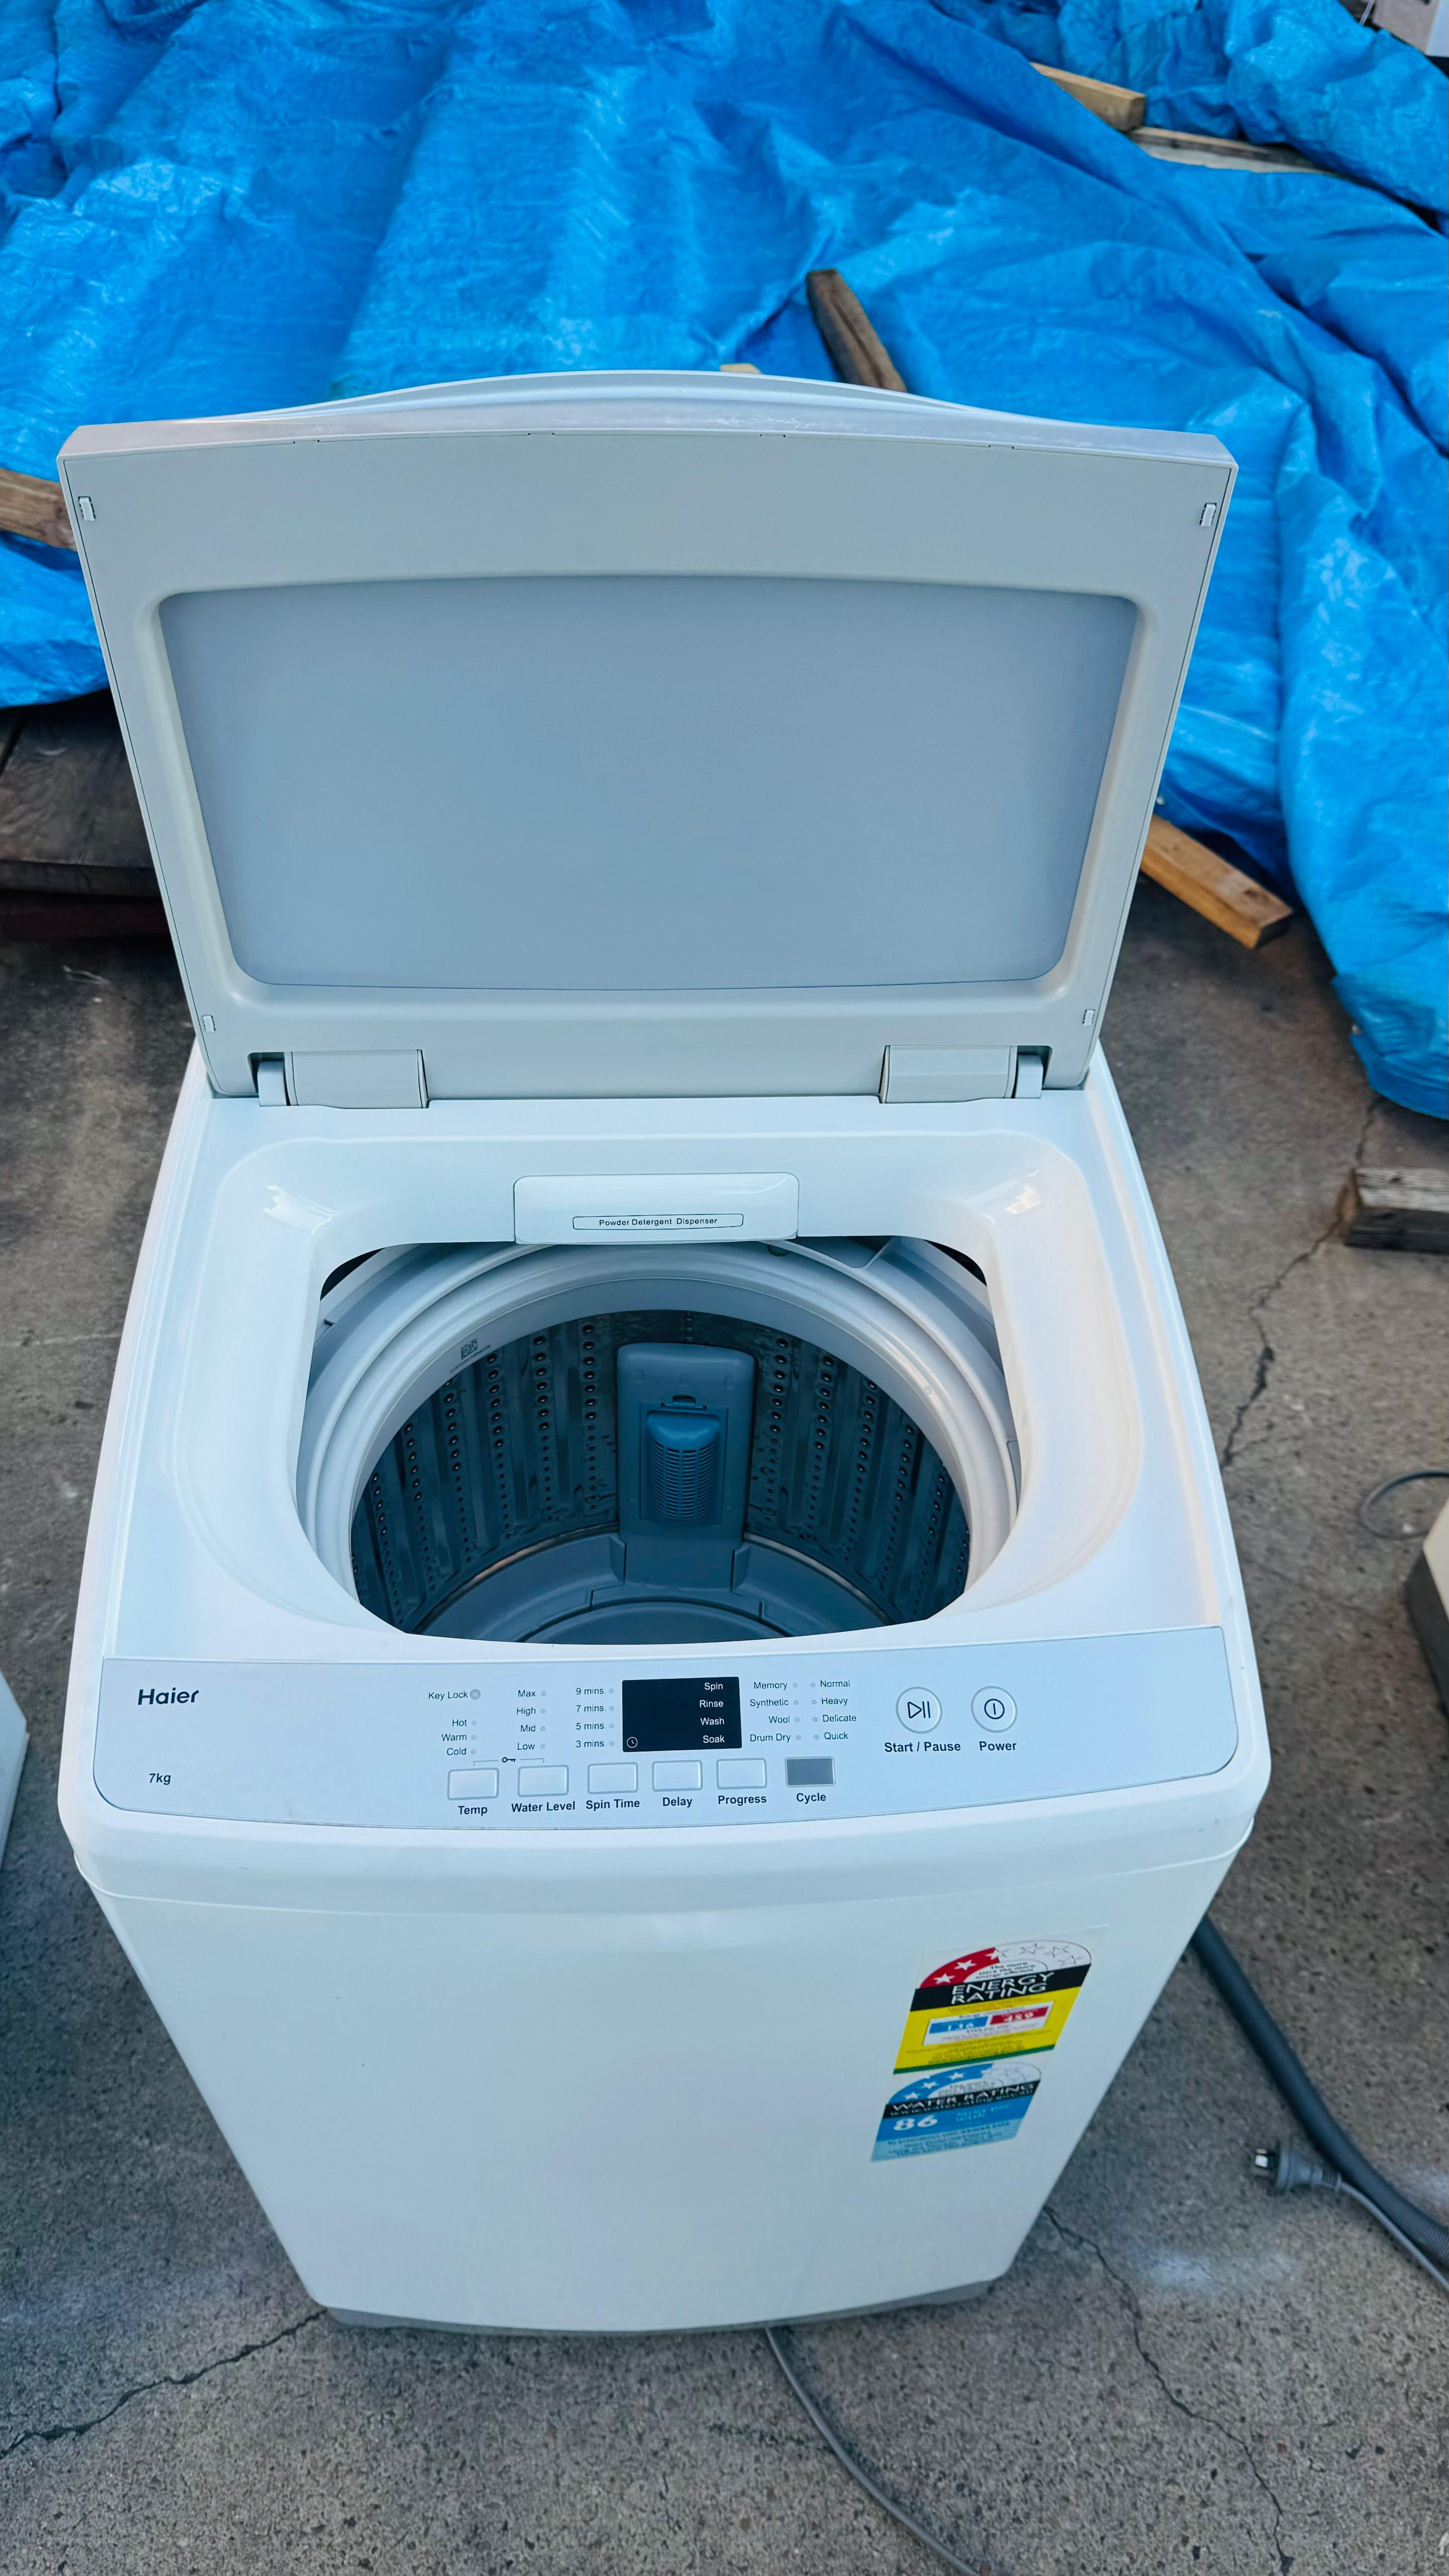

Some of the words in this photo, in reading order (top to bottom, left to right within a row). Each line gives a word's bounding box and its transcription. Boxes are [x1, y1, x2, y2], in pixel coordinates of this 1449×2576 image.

[704, 1682, 723, 1692] Spin
[754, 1681, 787, 1691] Memory
[820, 1679, 850, 1687] Normal
[428, 1692, 445, 1701] Key
[447, 1691, 468, 1699] Lock
[576, 1687, 582, 1695] 9
[137, 1687, 200, 1706] Haier
[699, 1700, 724, 1708] Rinse
[750, 1698, 789, 1709] Synthetic
[821, 1697, 848, 1707] Heavy
[516, 1707, 536, 1717] High
[576, 1705, 581, 1713] 7
[452, 1719, 467, 1727] Hot
[700, 1717, 725, 1726] Wash
[823, 1714, 857, 1722] Delicate
[520, 1724, 536, 1732] Mid
[576, 1722, 581, 1730] 5
[441, 1733, 467, 1741] Warm
[703, 1735, 725, 1743] Soak
[750, 1734, 773, 1742] Drum
[776, 1733, 791, 1743] Dry
[824, 1732, 849, 1740] Quick
[517, 1742, 535, 1750] Low
[576, 1740, 581, 1748] 3
[884, 1742, 914, 1752] Start
[917, 1741, 920, 1752] /
[924, 1741, 961, 1751] Pause
[979, 1741, 1017, 1751] Power
[446, 1747, 466, 1756] Cold
[149, 1773, 171, 1786] 7kg
[663, 1796, 693, 1808] Delay
[718, 1795, 767, 1806] Progress
[796, 1792, 826, 1804] Cycle
[457, 1805, 488, 1816] Temp
[511, 1803, 543, 1813] Water
[546, 1801, 575, 1811] Level
[586, 1799, 610, 1812] Spin
[613, 1799, 640, 1808] Time
[952, 1972, 1055, 1995] ENERGY
[951, 1982, 1048, 2004] RATING
[894, 2115, 938, 2131] 86
